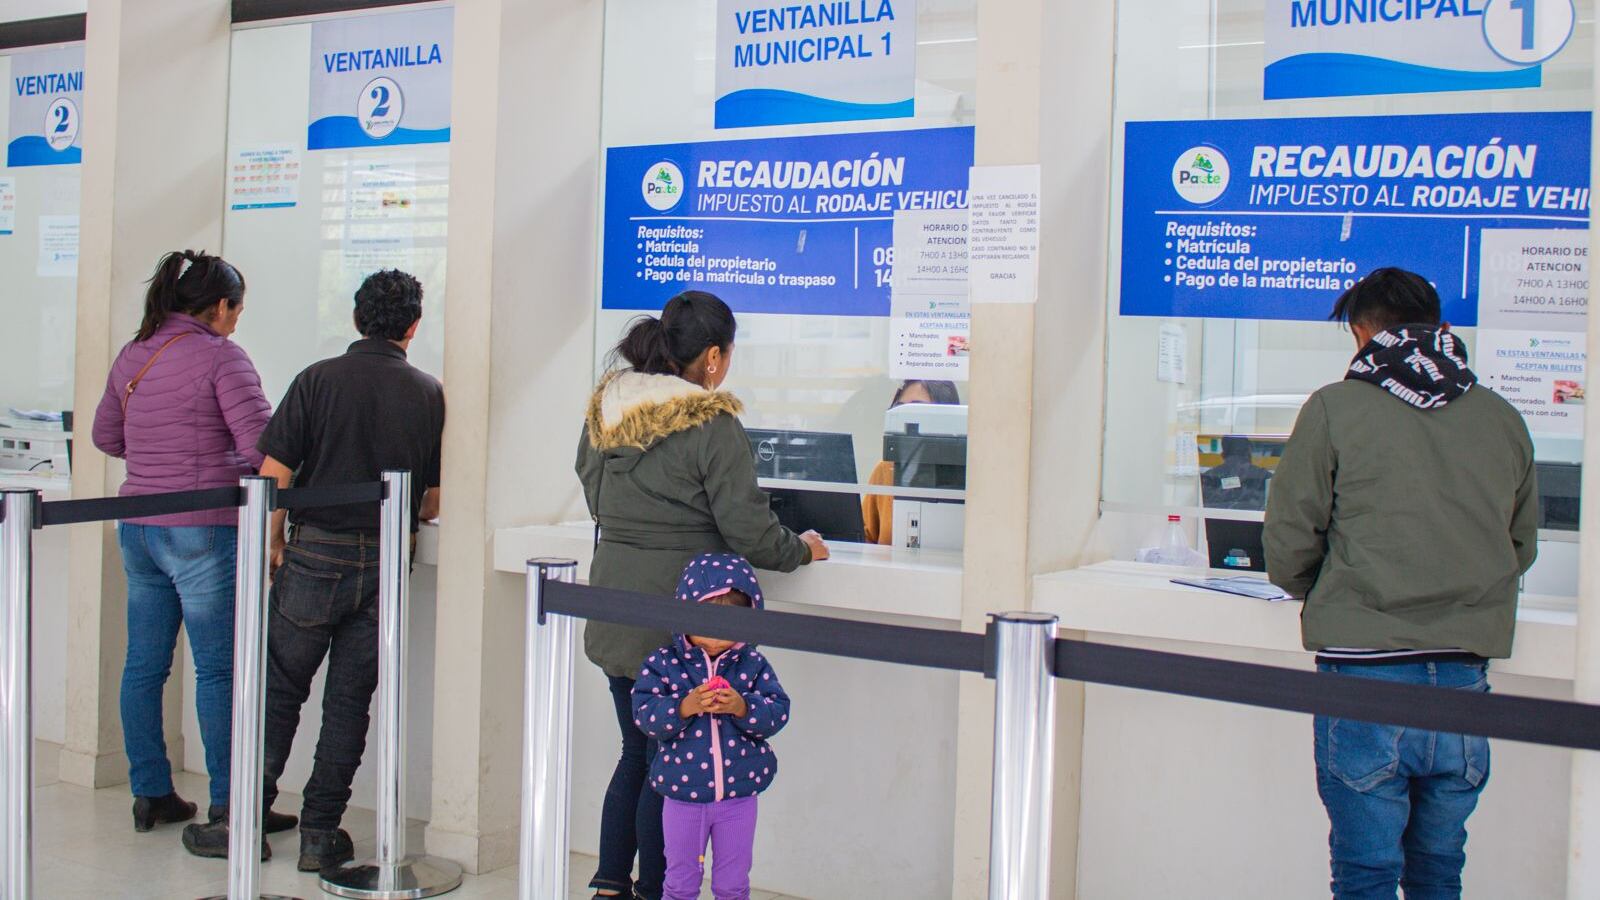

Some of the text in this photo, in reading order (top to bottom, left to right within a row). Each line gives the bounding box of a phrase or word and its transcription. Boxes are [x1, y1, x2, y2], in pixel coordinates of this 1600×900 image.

[735, 0, 895, 35] VENTANILLA
[1290, 0, 1483, 28] MUNICIPAL
[1509, 0, 1535, 50] 1
[323, 43, 442, 74] VENTANILLA
[734, 32, 891, 68] MUNICIPAL 1
[371, 86, 391, 118] 2
[54, 105, 70, 134] 2
[1249, 137, 1537, 179] RECAUDACIÓN
[697, 152, 906, 189] RECAUDACIÓN
[697, 194, 784, 213] IMPUESTO
[787, 195, 811, 213] AL
[816, 192, 893, 213] RODAJE
[1249, 184, 1591, 211] IMPUESTO AL RODAJE VEHI
[638, 225, 704, 241] Requisitos:
[923, 224, 960, 232] HORARIO
[1166, 221, 1257, 239] Requisitos:
[645, 240, 699, 253] Matrícula
[927, 237, 967, 245] ATENCION
[1176, 239, 1251, 254] Matrícula
[941, 251, 946, 259] A
[1521, 247, 1588, 256] HORARIO DE
[645, 254, 776, 274] Cedula del propietario
[1175, 255, 1356, 275] Cedula del propietario
[1526, 262, 1581, 272] ATENCION
[644, 269, 836, 289] Pago de la matricula o traspaso
[1175, 272, 1354, 290] Pago de la matricula o
[1517, 278, 1543, 288] 7H00
[1546, 279, 1553, 288] A
[1513, 295, 1546, 305] 14H00
[1548, 296, 1555, 305] A
[1531, 351, 1579, 359] VENTANILLAS
[1515, 362, 1583, 372] ACEPTAN BILLETES
[1501, 374, 1541, 382] Manchados
